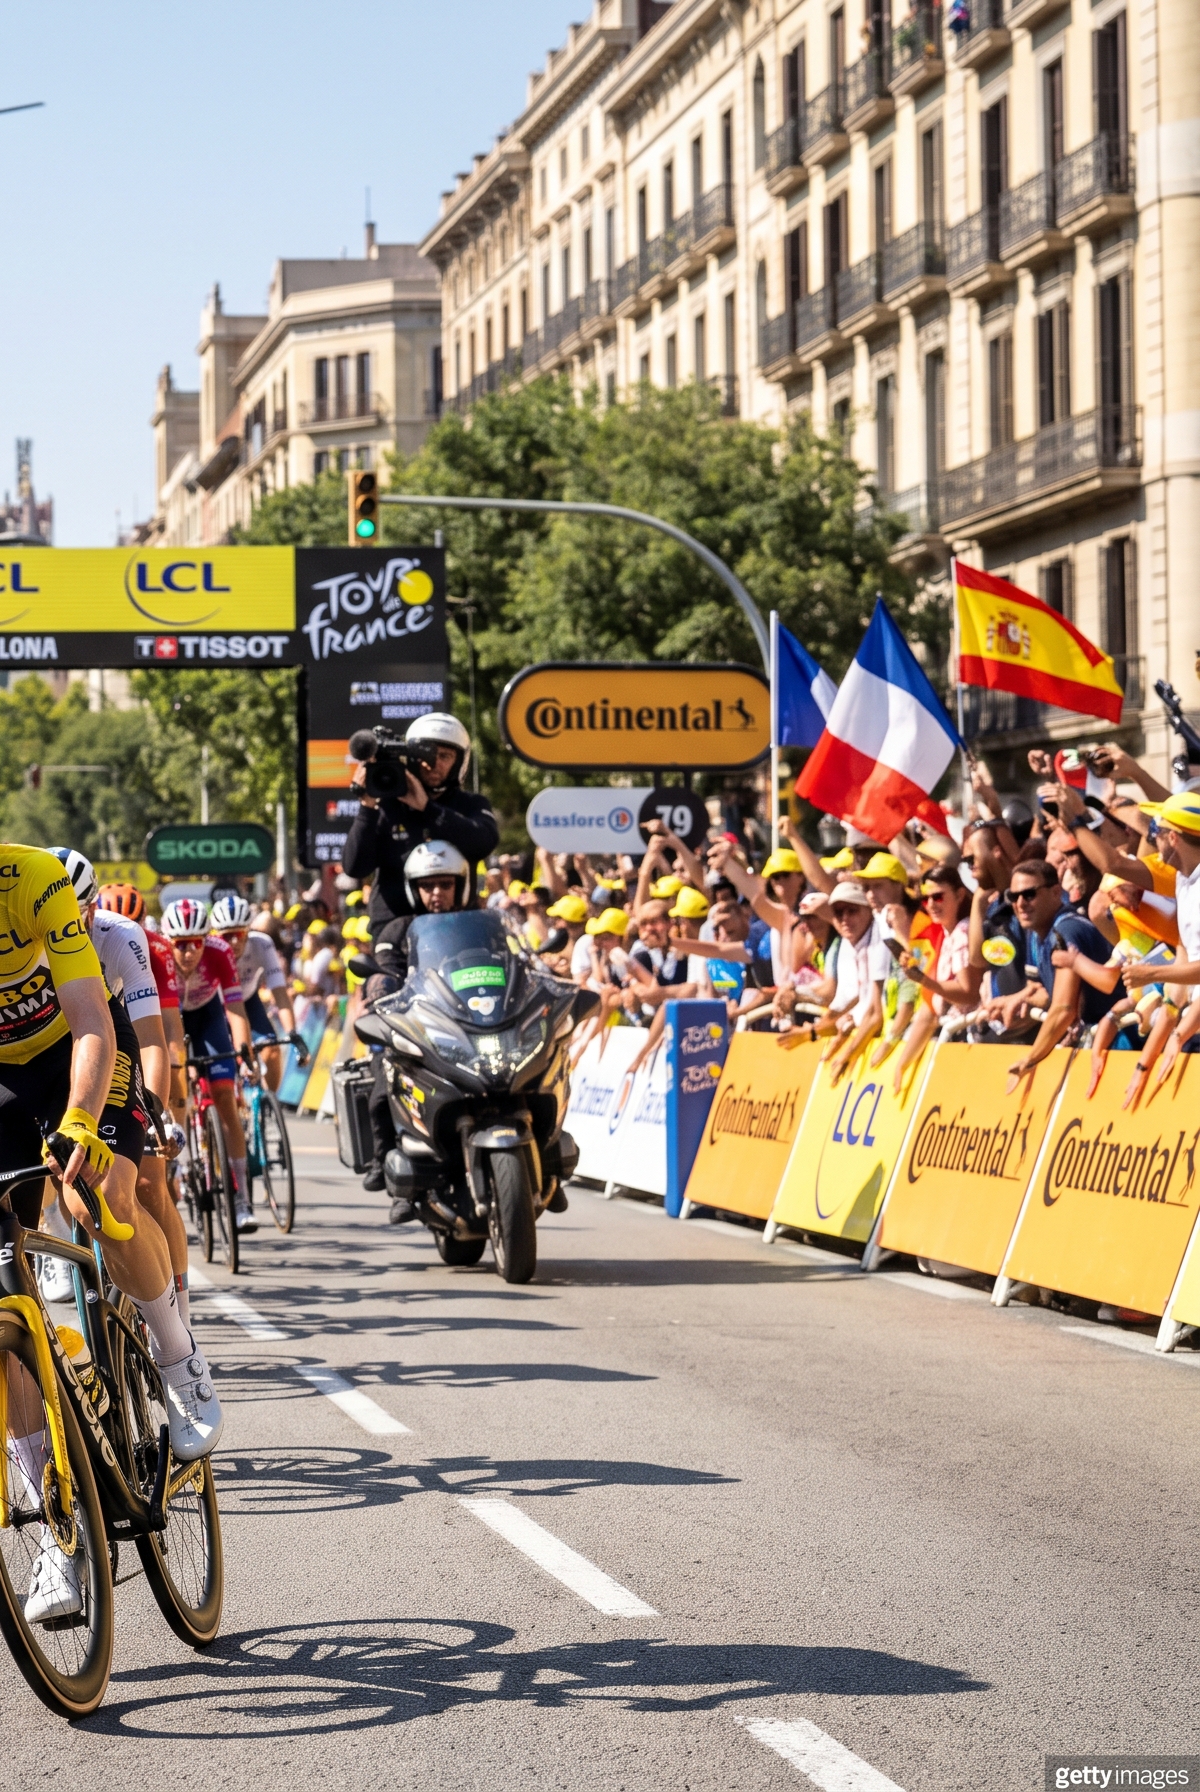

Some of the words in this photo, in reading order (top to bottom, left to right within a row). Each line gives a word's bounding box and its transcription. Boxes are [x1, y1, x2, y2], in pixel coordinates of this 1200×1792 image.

[136, 561, 231, 593] LCL
[179, 636, 289, 659] TISSOT
[525, 697, 723, 739] Continental
[655, 804, 693, 838] 79
[156, 839, 262, 860] SKODA
[49, 919, 86, 944] LCL
[709, 1083, 791, 1146] Continental
[832, 1081, 884, 1148] LCL
[907, 1103, 1022, 1184] Continental
[1043, 1115, 1186, 1207] Continental
